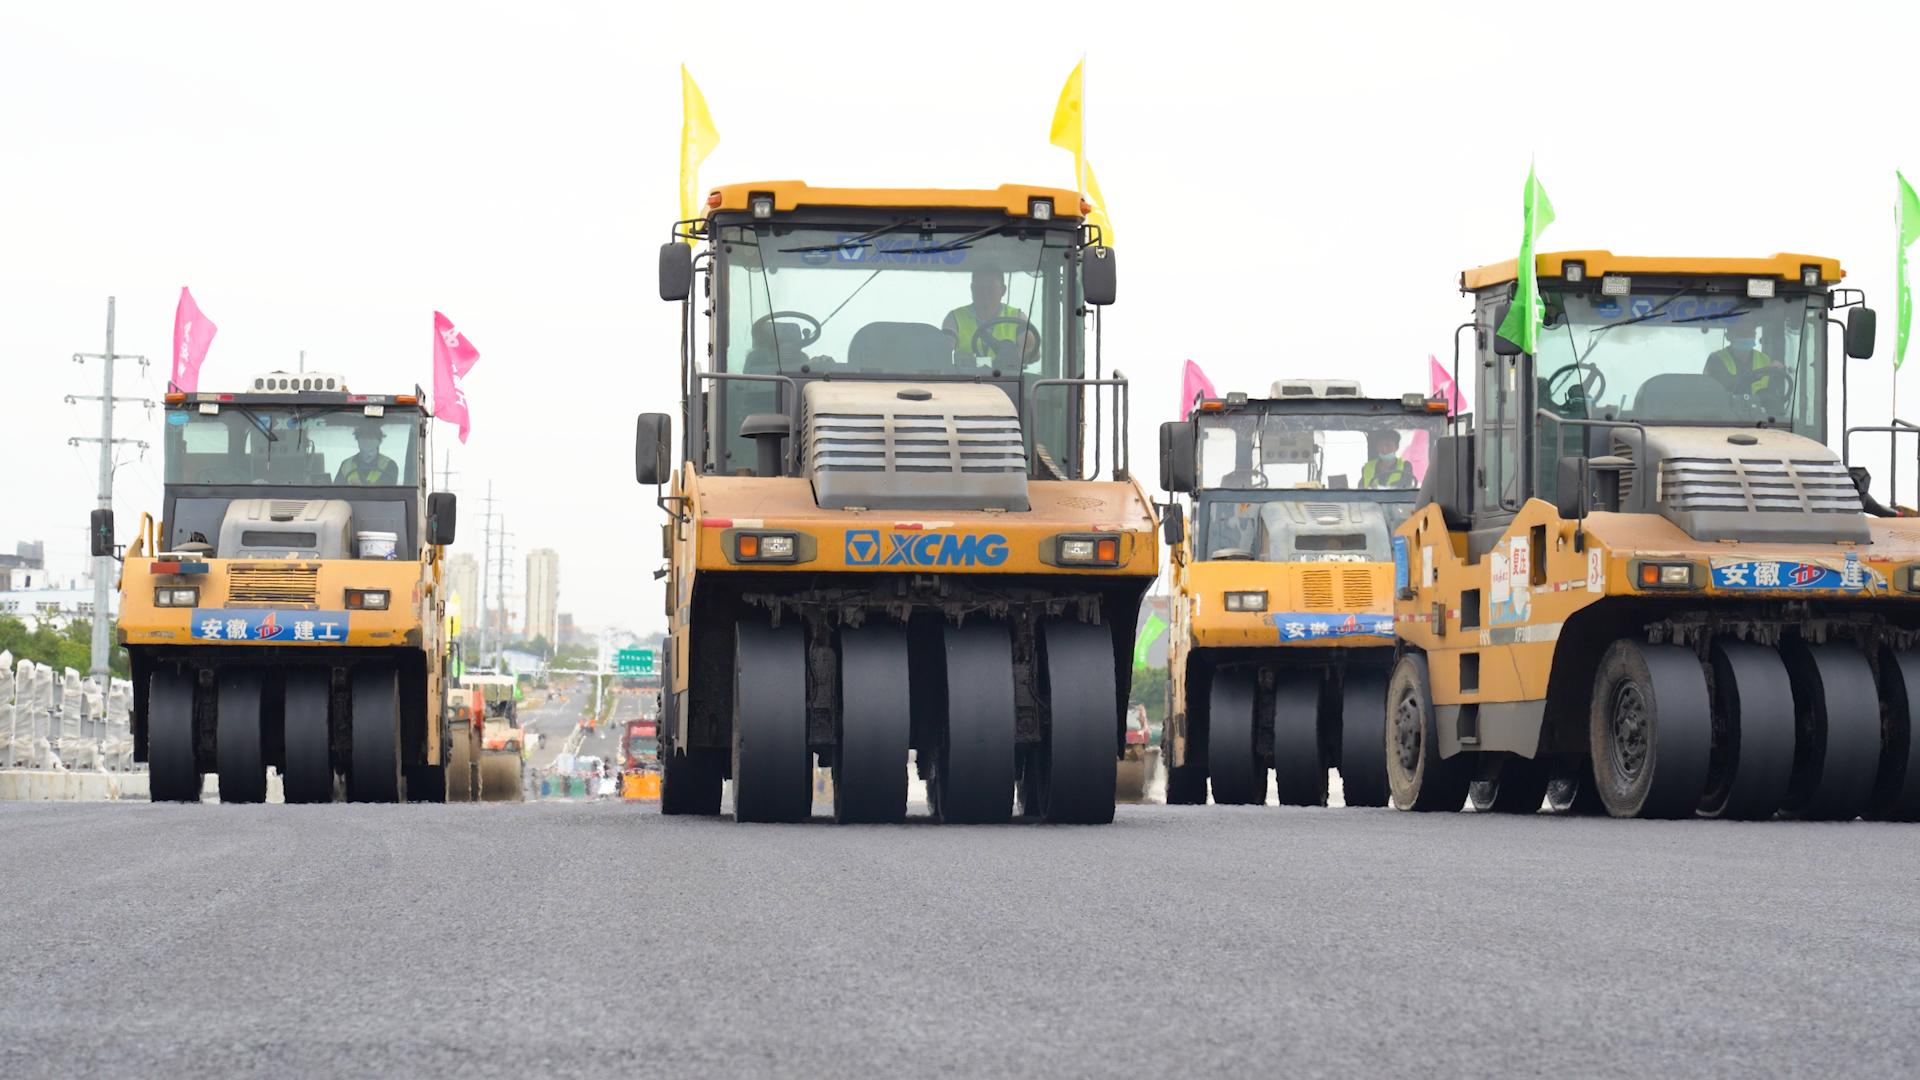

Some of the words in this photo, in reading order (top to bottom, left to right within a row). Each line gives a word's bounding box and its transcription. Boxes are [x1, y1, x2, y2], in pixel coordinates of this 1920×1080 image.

[881, 533, 1009, 566] XCMG
[1591, 553, 1600, 585] 3
[1721, 562, 1781, 587] 安徽
[201, 618, 248, 640] 安徽
[293, 620, 341, 640] 建工
